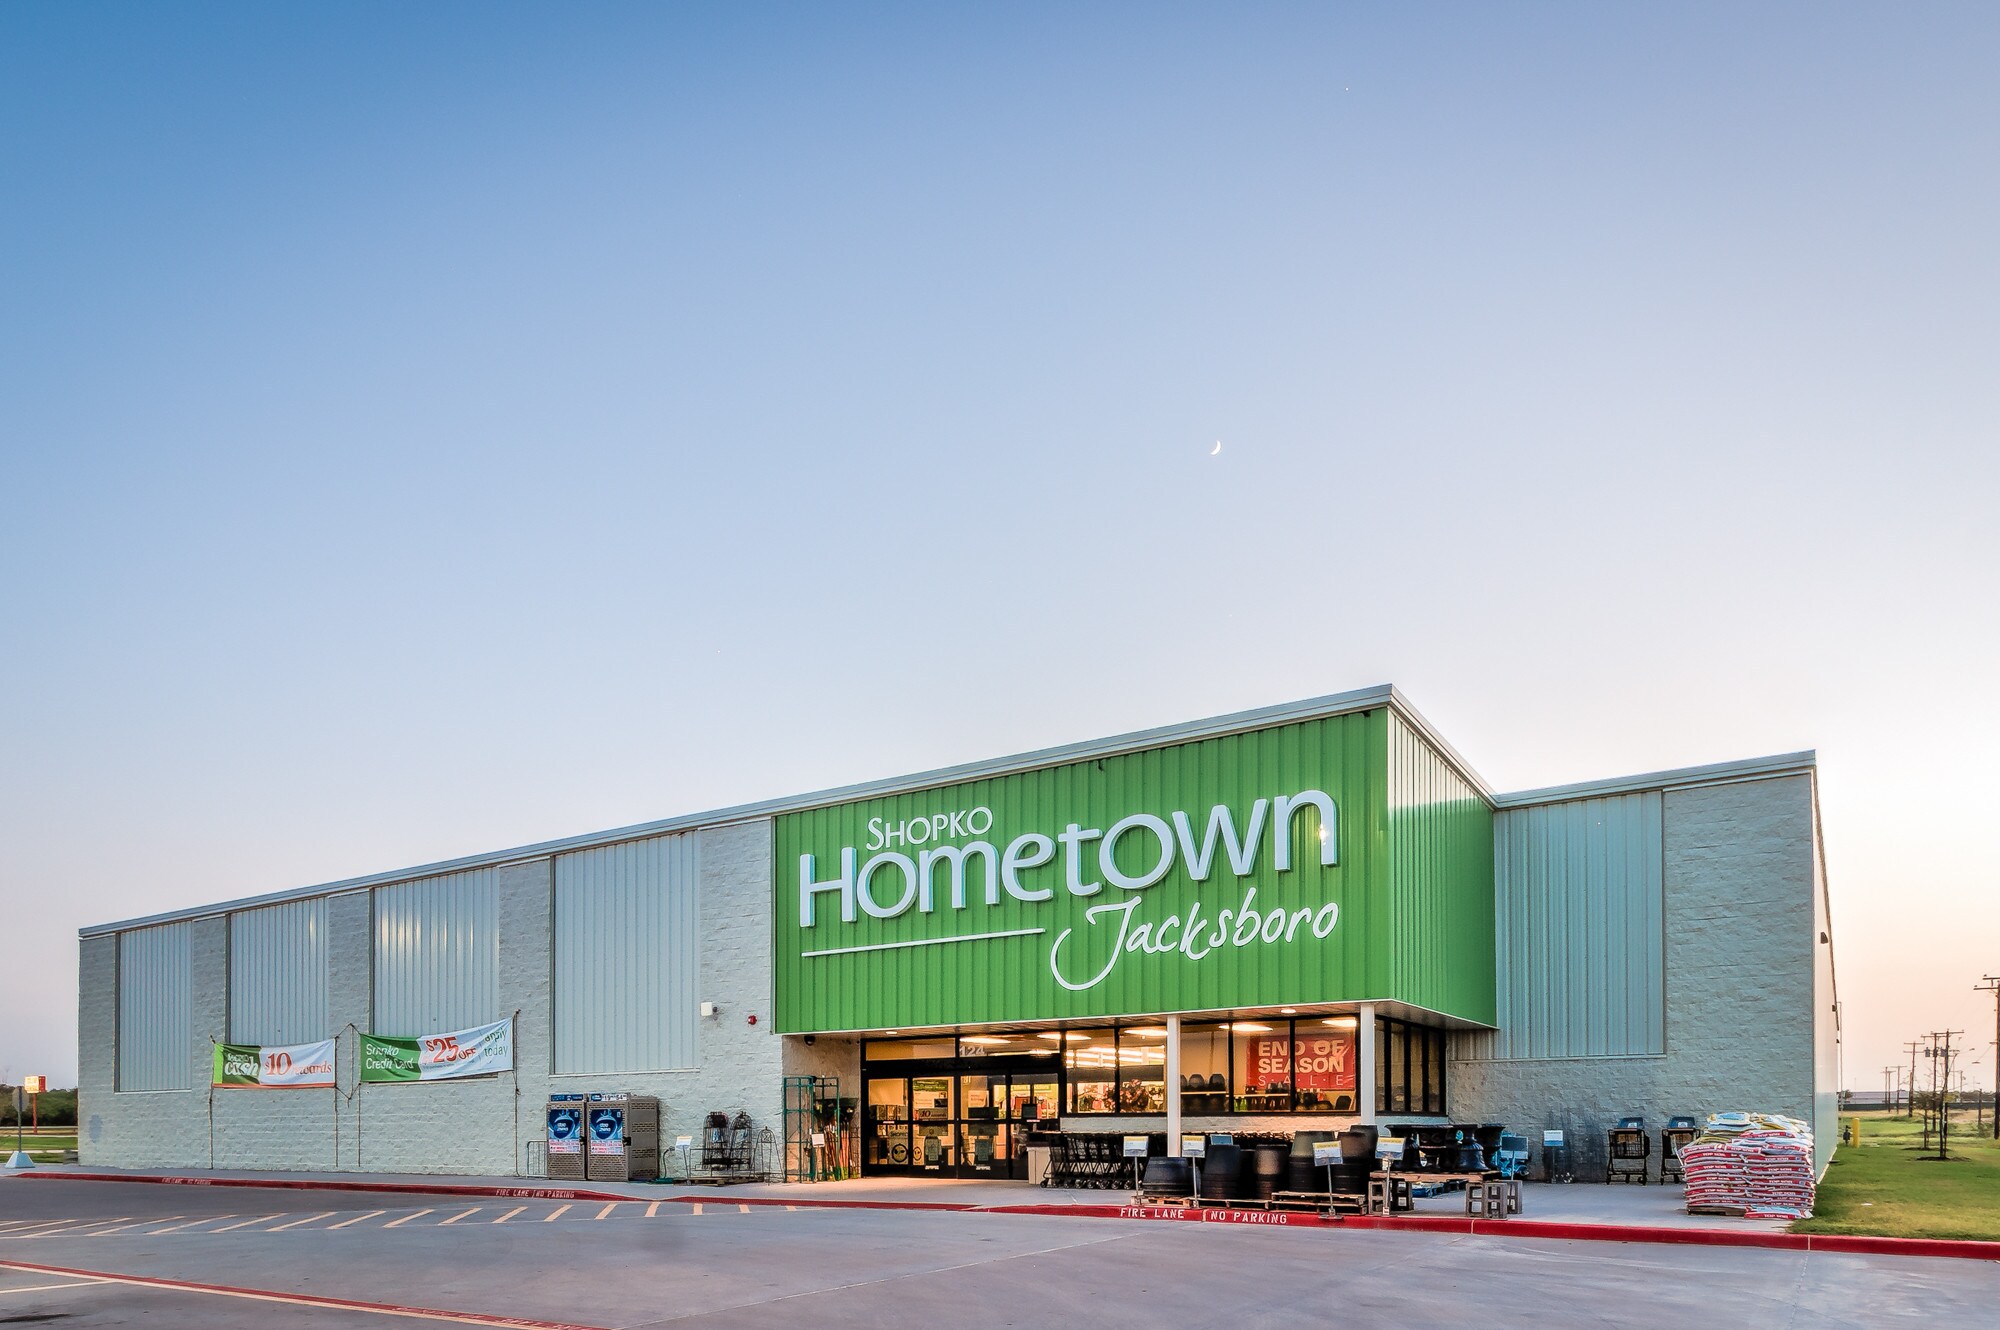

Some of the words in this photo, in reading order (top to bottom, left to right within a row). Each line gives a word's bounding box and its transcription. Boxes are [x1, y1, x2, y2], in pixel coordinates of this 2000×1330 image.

[799, 788, 1338, 928] Hometown
[1050, 887, 1340, 991] Jacksboro
[425, 1036, 459, 1063] $25
[458, 1047, 476, 1060] OFF
[1258, 1041, 1306, 1057] END
[1313, 1039, 1345, 1057] OF
[264, 1051, 292, 1076] $10
[1258, 1057, 1345, 1074] SEASON
[496, 1188, 510, 1196] FIRE
[547, 1190, 575, 1199] PARKING
[1120, 1207, 1147, 1218] FIRE
[1154, 1208, 1185, 1219] LANE
[1210, 1210, 1226, 1221] NO
[1233, 1211, 1287, 1224] PARKING
